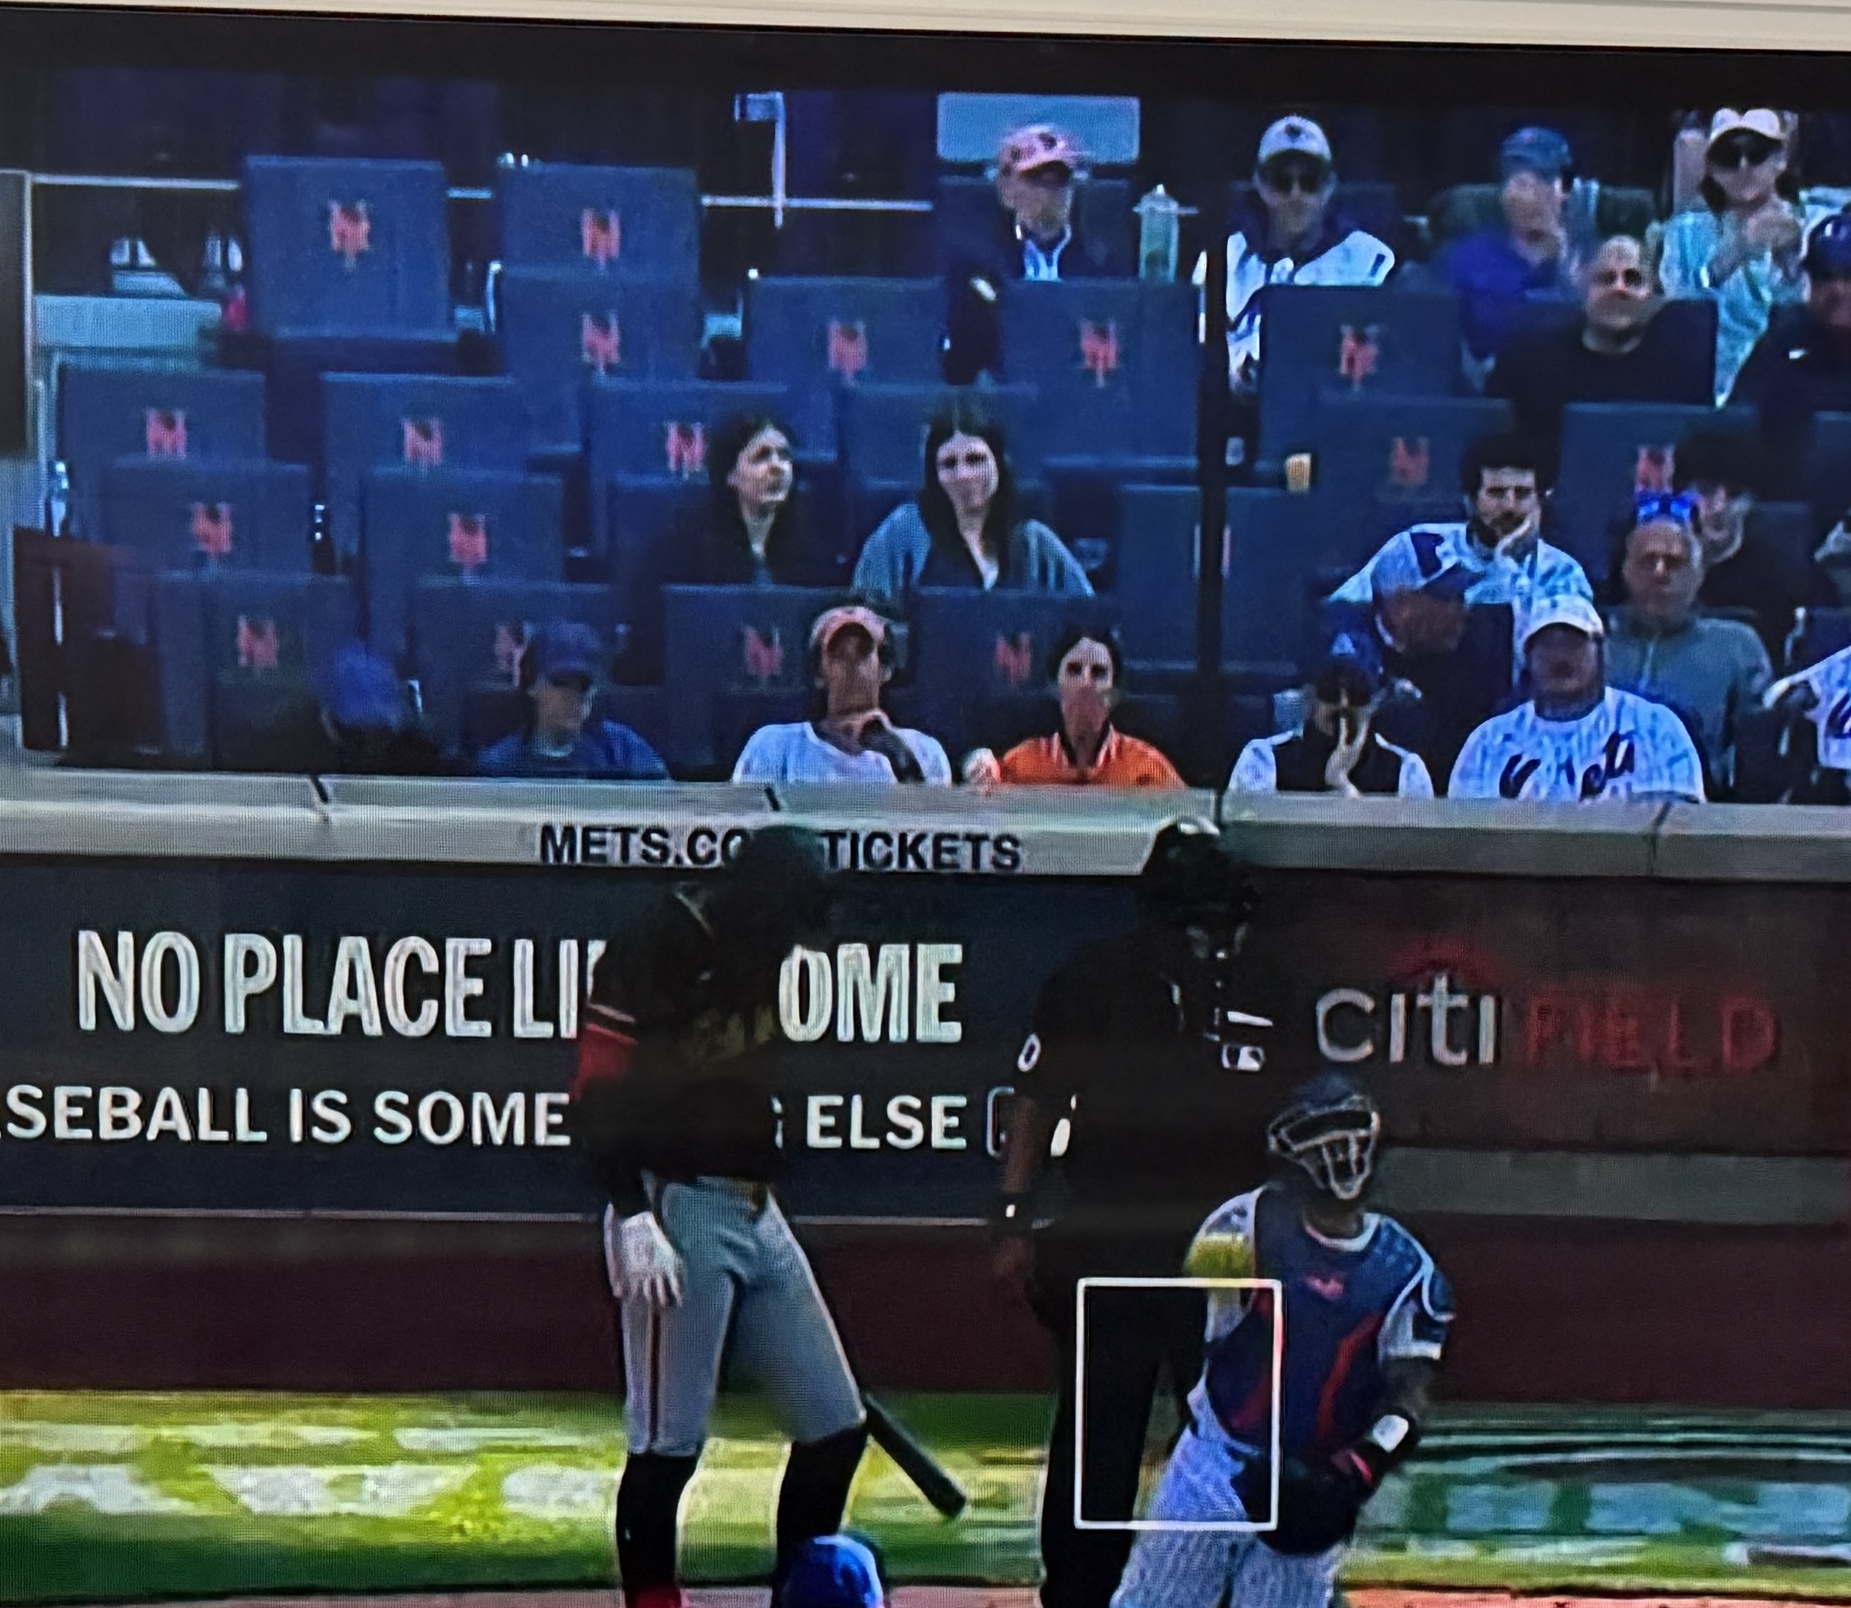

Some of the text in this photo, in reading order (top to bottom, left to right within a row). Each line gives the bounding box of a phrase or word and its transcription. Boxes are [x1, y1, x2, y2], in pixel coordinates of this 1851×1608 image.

[77, 930, 200, 1034] NO
[225, 933, 492, 1038] PLACE
[1315, 972, 1503, 1066] citi
[289, 1087, 352, 1144] IS
[806, 1093, 967, 1151] ELSE
